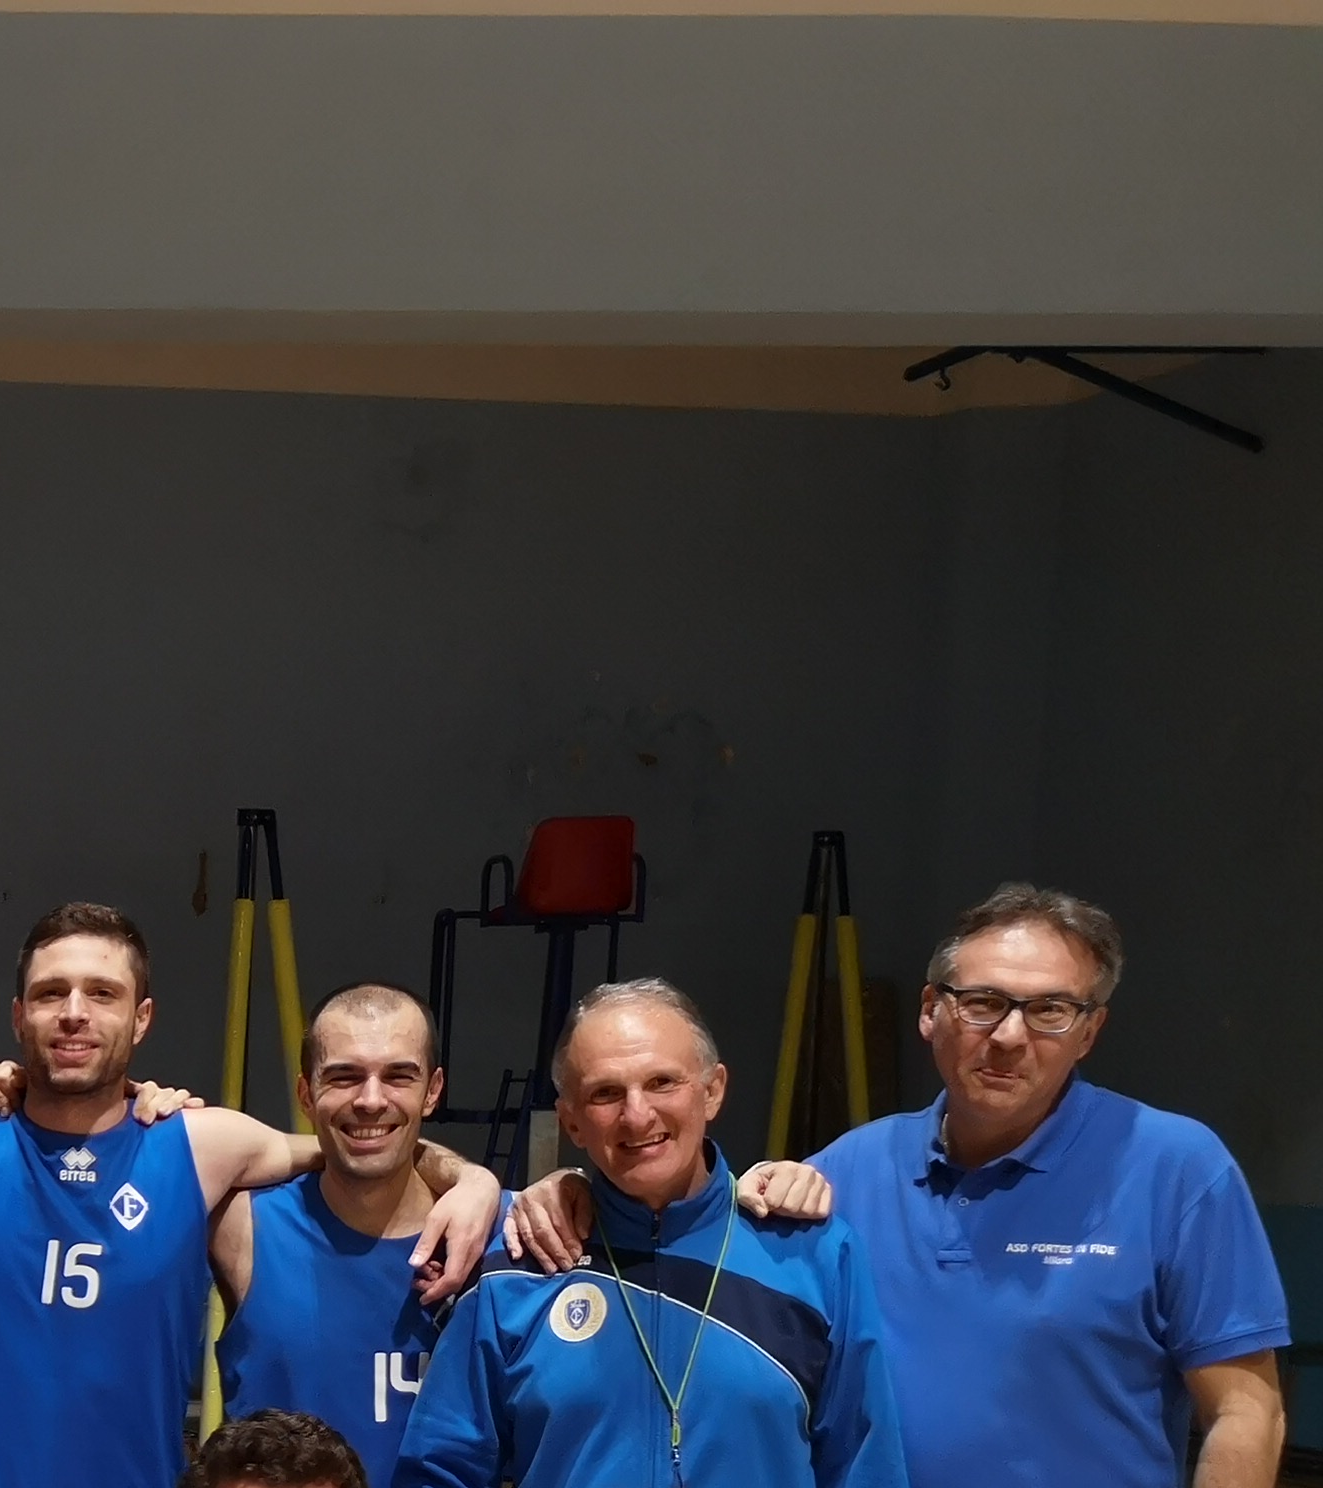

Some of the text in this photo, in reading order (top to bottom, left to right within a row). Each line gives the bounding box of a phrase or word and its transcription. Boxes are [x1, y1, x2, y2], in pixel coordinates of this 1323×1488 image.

[60, 1168, 97, 1183] errea
[41, 1239, 103, 1309] 15
[374, 1352, 430, 1422] 14
